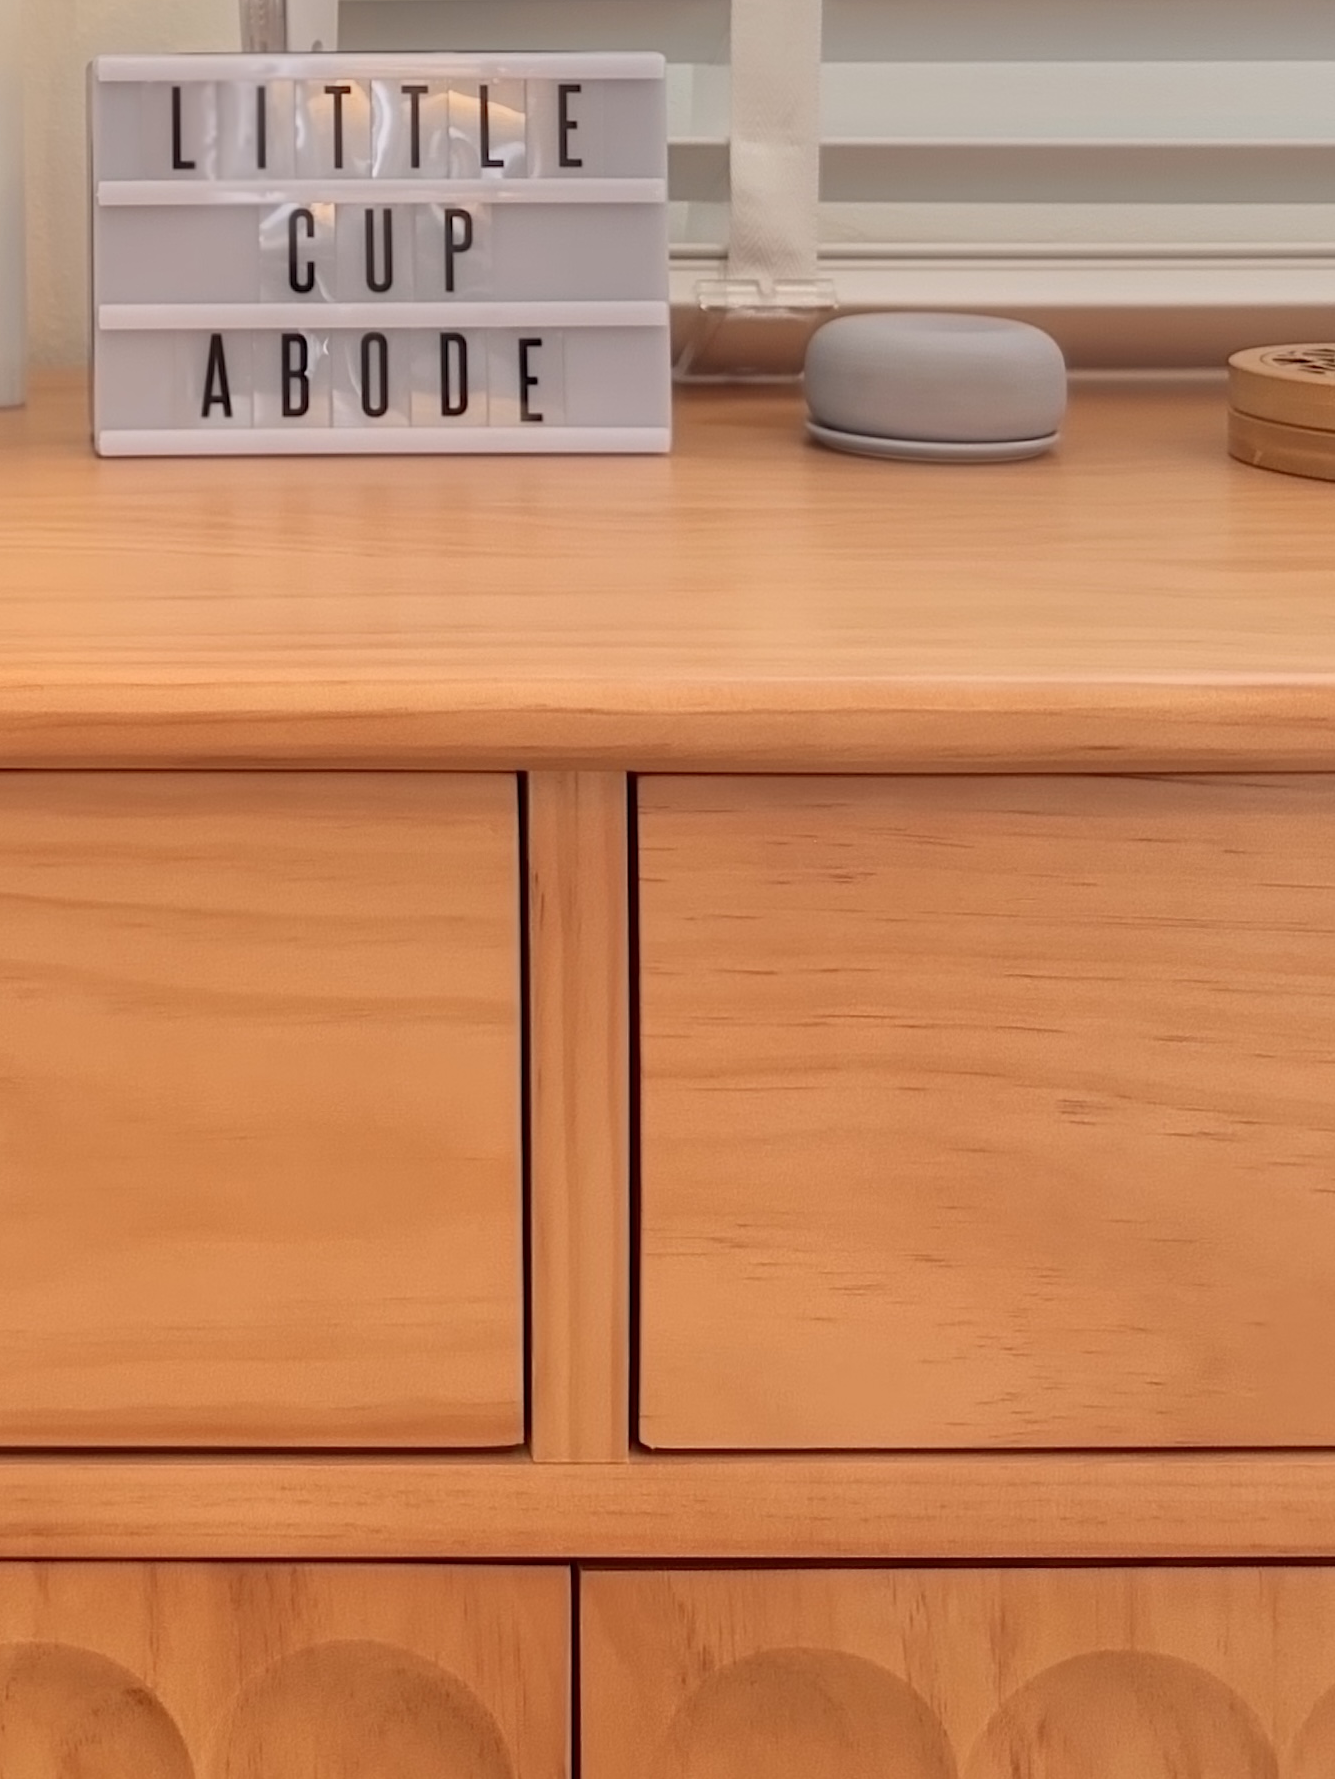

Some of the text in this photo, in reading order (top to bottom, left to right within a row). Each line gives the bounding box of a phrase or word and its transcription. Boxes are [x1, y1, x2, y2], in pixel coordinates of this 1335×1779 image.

[171, 83, 583, 170] LITTLE
[287, 207, 473, 294] CUP
[201, 331, 544, 422] ABODE
